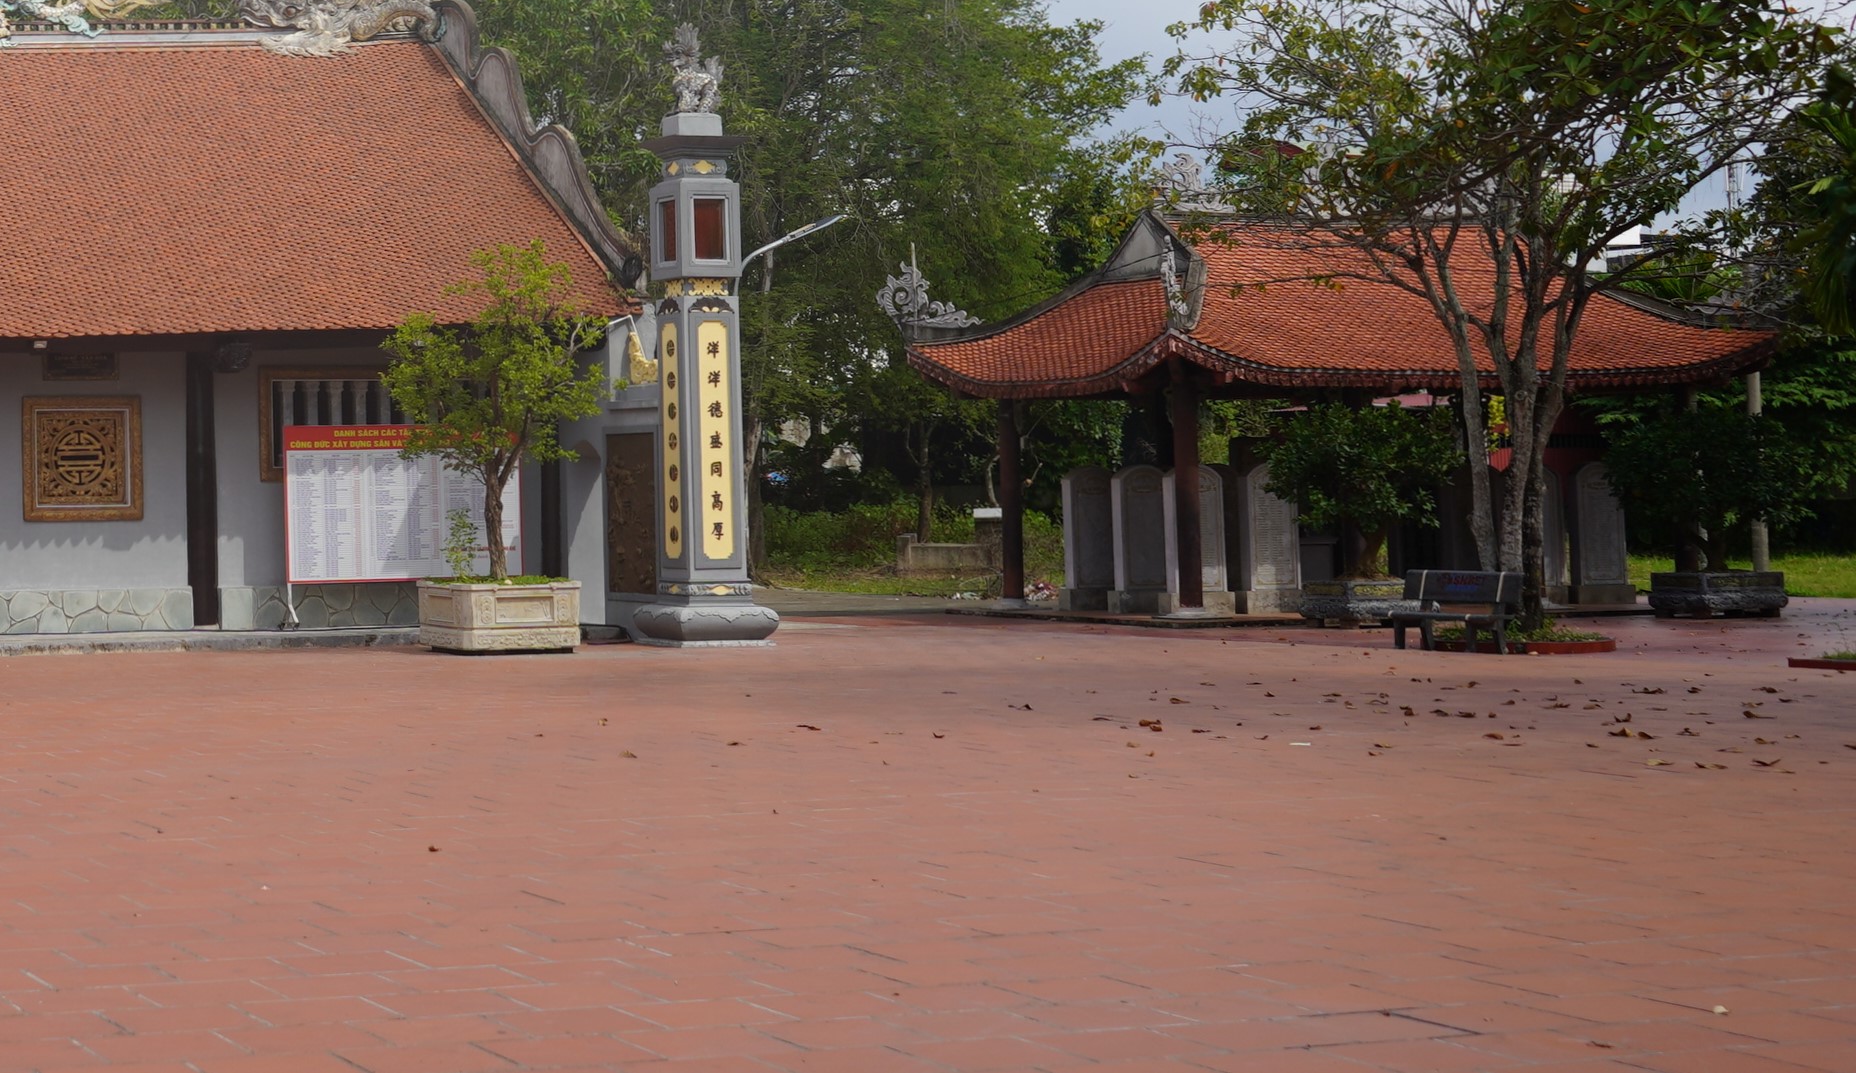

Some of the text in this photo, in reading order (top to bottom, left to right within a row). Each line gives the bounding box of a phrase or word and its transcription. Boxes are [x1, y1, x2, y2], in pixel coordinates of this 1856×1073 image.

[357, 429, 379, 437] SÁCH
[380, 428, 397, 436] CÁC
[290, 440, 312, 448] CÔNG
[314, 440, 330, 448] ĐỨC
[332, 439, 348, 448] XÂY
[350, 439, 372, 448] DỰNG
[373, 439, 390, 447] SÂN
